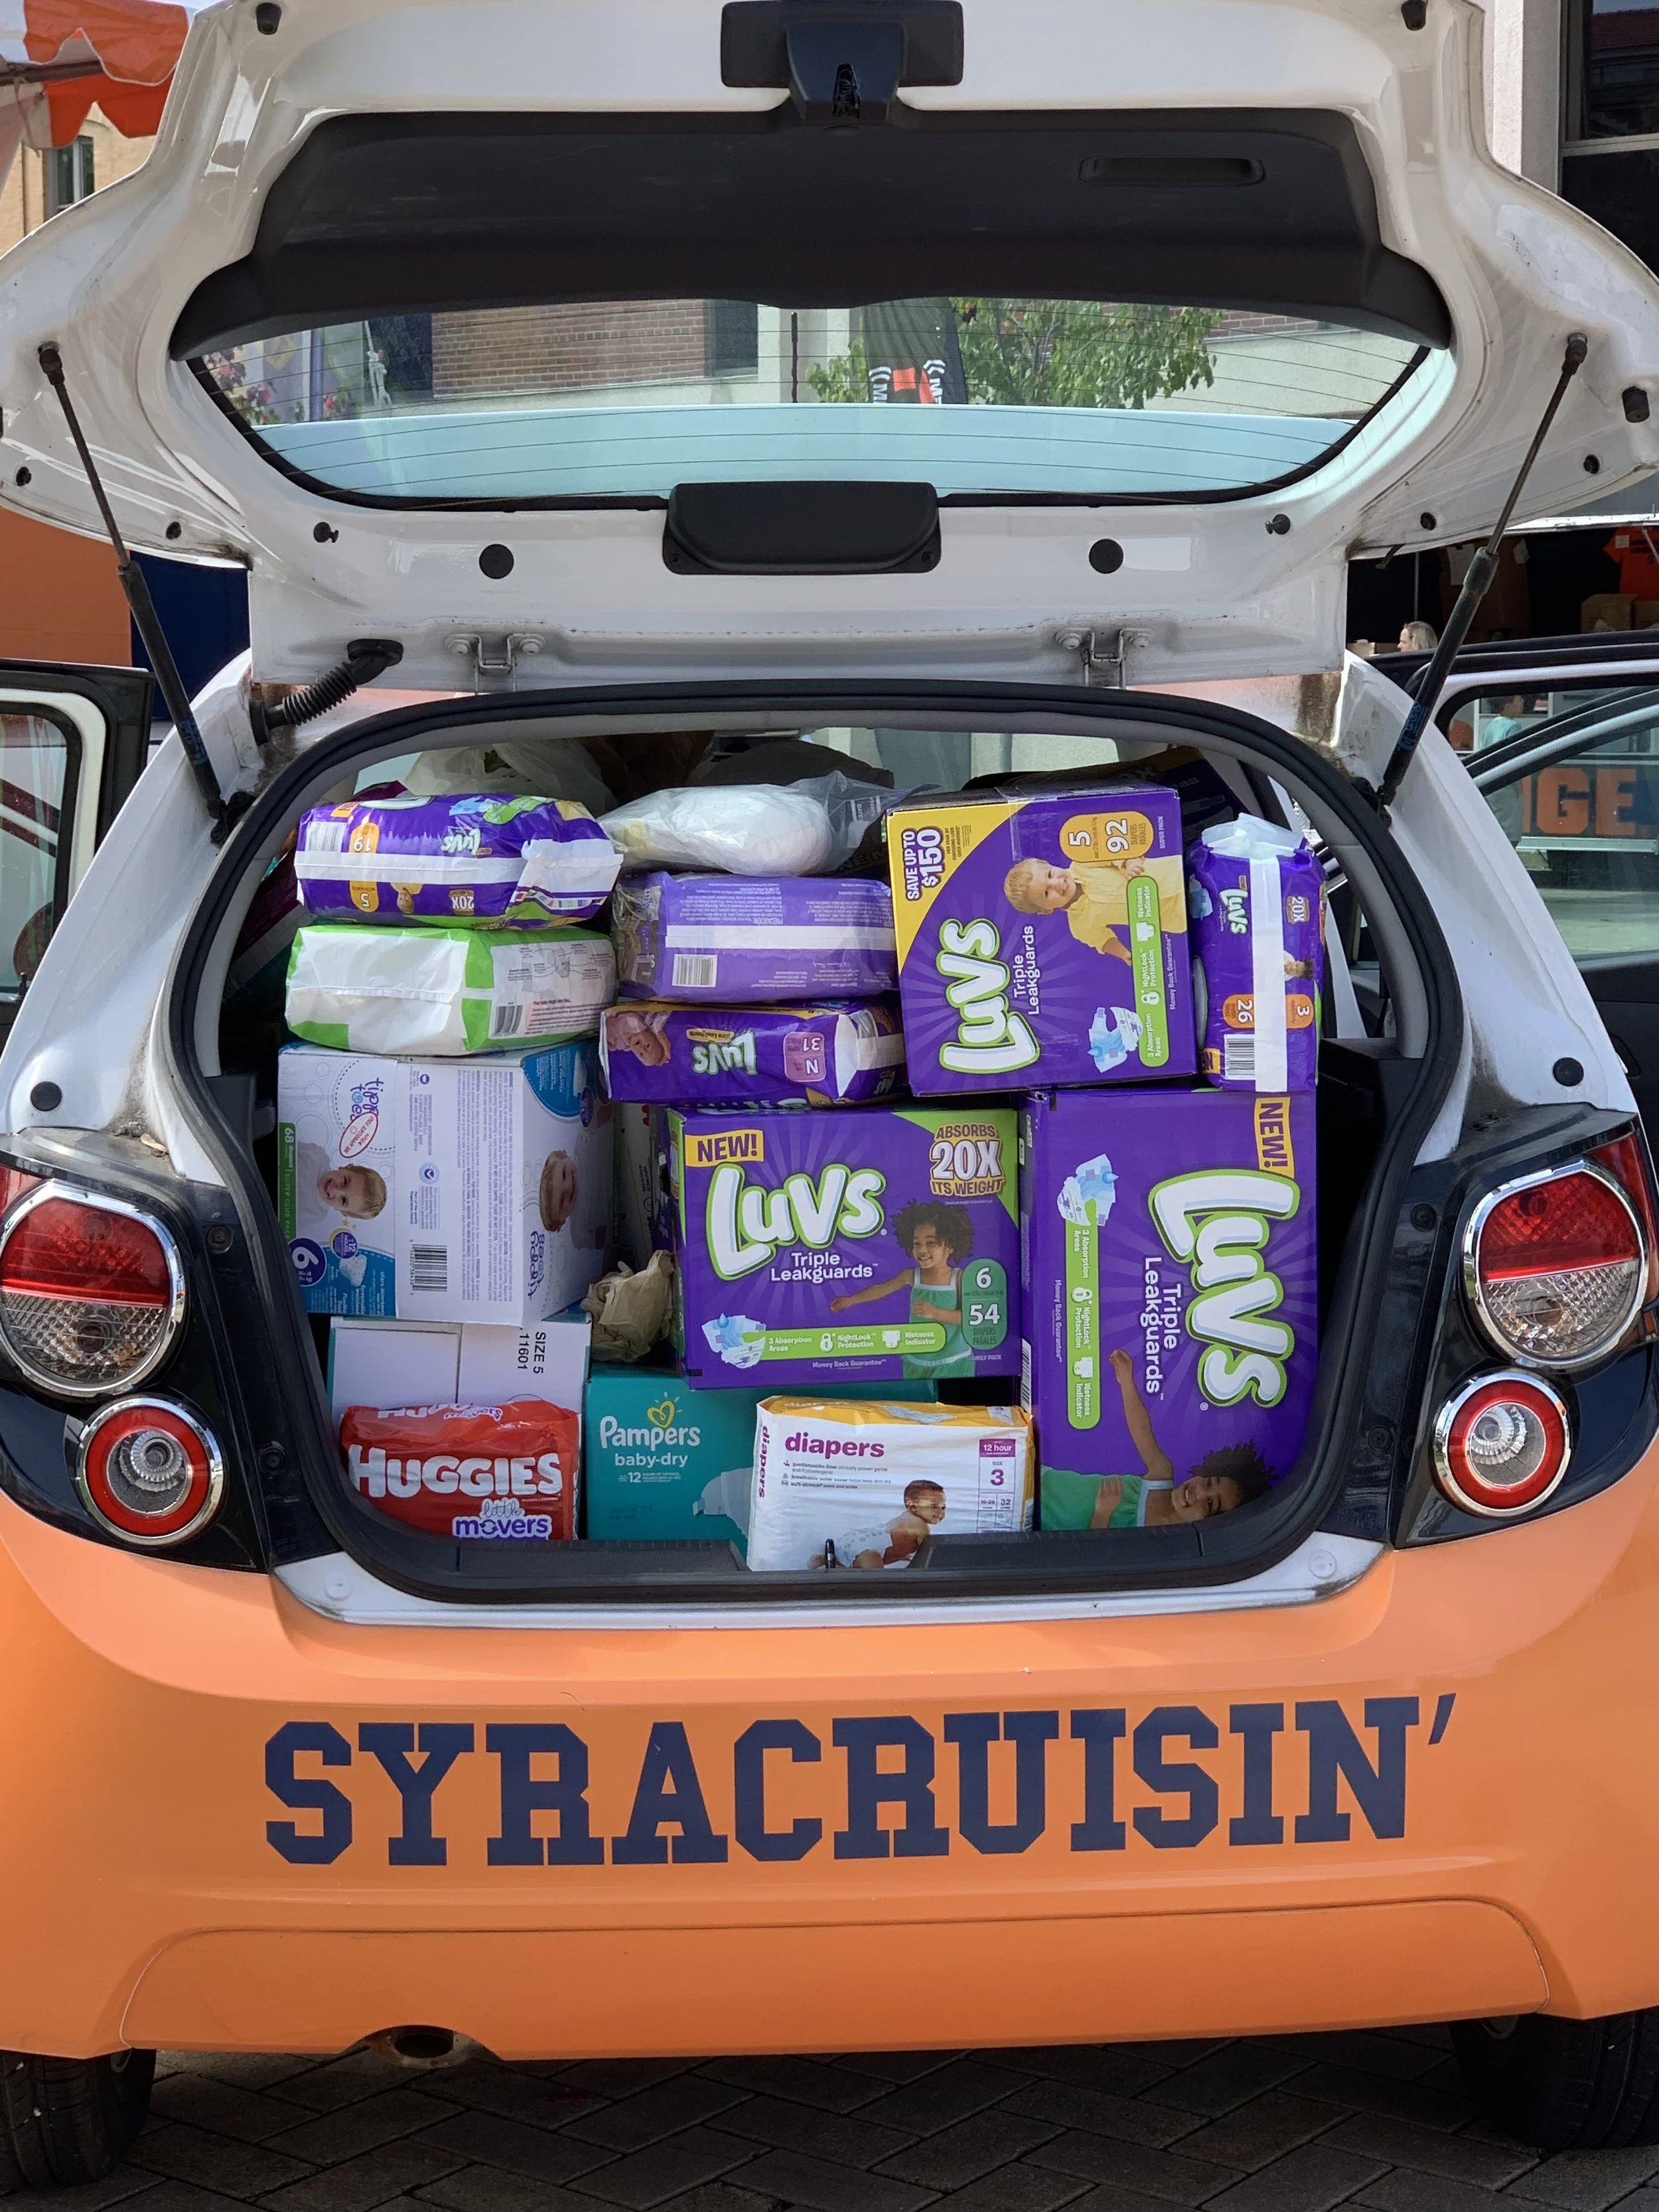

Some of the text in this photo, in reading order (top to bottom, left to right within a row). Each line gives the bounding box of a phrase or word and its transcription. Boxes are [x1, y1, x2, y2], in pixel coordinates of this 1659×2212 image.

[353, 836, 372, 853] 19
[441, 828, 482, 856] Luvs
[1068, 830, 1092, 847] 5
[1104, 818, 1129, 853] 92
[1129, 823, 1139, 846] DIAPERS
[902, 831, 920, 900] SAVE UP TO
[916, 828, 944, 887] $150
[360, 893, 370, 908] 5
[452, 895, 475, 909] 20X
[1135, 887, 1144, 918] Wetness
[1143, 884, 1152, 918] Indicator
[1218, 888, 1248, 934] Luvs
[1291, 896, 1305, 923] 20X
[1014, 953, 1027, 998] Triple
[1027, 924, 1042, 1015] Leakguards
[1147, 948, 1157, 987] Protection
[1167, 972, 1175, 988] Back
[941, 919, 1039, 1071] Luvs
[1168, 989, 1177, 1010] Money
[1238, 999, 1254, 1023] 26
[1297, 1005, 1310, 1016] 3
[802, 1037, 822, 1053] 31
[1144, 1012, 1154, 1052] Absorption
[691, 1030, 758, 1075] Luvs
[1153, 1037, 1162, 1058] Areas
[805, 1059, 819, 1074] N
[362, 1077, 384, 1118] tipp
[285, 1127, 295, 1143] 68
[936, 1124, 997, 1139] ABSORBS
[1258, 1101, 1288, 1169] NEW!
[697, 1134, 758, 1163] NEW!
[931, 1140, 1002, 1181] 20X
[931, 1181, 953, 1194] ITS
[709, 1165, 886, 1279] Luvs
[294, 1245, 319, 1270] 6
[348, 1242, 356, 1252] 12
[791, 1252, 841, 1268] Triple
[1080, 1236, 1090, 1278] Absorption
[528, 1230, 541, 1301] tippy
[975, 1266, 992, 1288] 6
[1053, 1279, 1062, 1303] Money
[1150, 1170, 1298, 1406] Luvs
[969, 1303, 1001, 1325] 54
[1074, 1307, 1082, 1349] Protection
[1163, 1283, 1182, 1351] Triple
[774, 1337, 813, 1346] Absorption
[905, 1337, 936, 1346] Indicator
[973, 1327, 996, 1335] DIAPERS
[517, 1333, 530, 1371] 11601
[533, 1331, 547, 1374] SIZE 5
[1075, 1383, 1084, 1418] Indicator
[1083, 1382, 1092, 1416] Wetness
[599, 1416, 701, 1452] Pampers
[784, 1432, 885, 1460] diapers
[348, 1443, 563, 1499] HUGGIES
[614, 1452, 688, 1468] baby-dry
[758, 1425, 770, 1499] diapers
[627, 1471, 642, 1483] 12
[990, 1469, 1005, 1486] 3
[480, 1499, 524, 1518] little
[455, 1516, 550, 1538] movers
[264, 1692, 1457, 1867] SYRACRUISIN'
